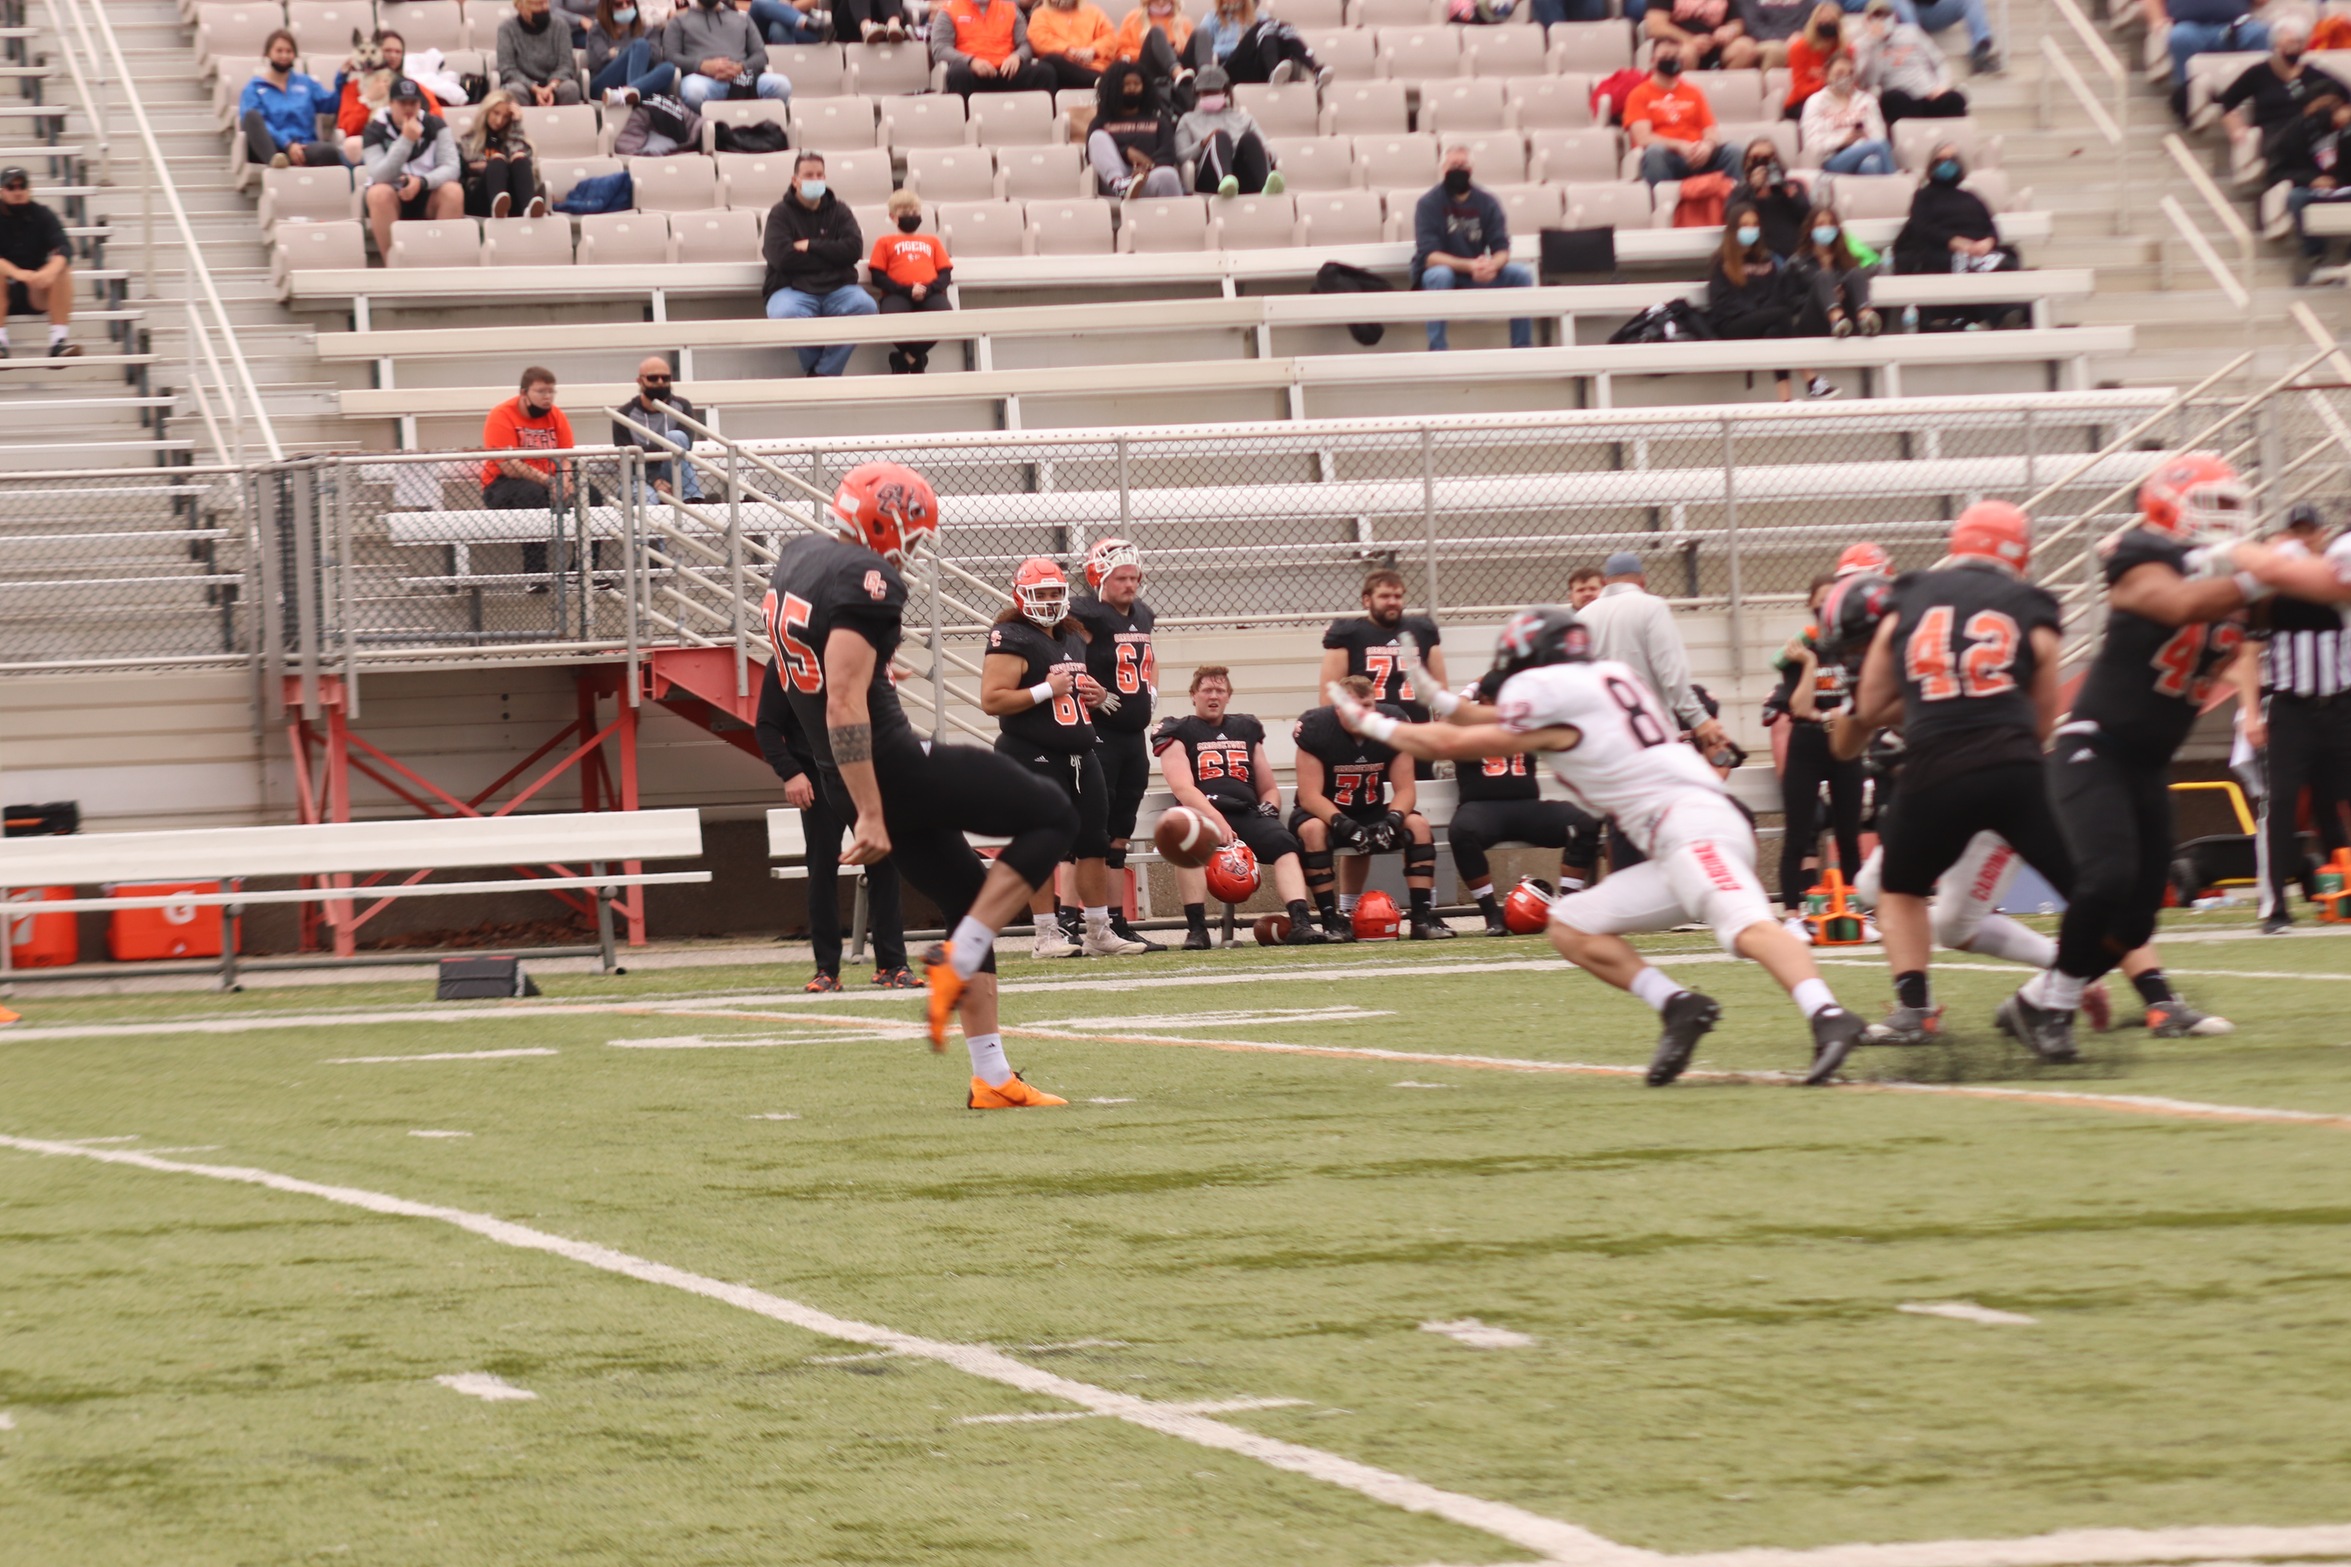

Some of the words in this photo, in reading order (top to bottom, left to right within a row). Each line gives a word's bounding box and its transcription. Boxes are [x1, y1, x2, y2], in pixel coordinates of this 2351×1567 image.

[894, 241, 932, 258] TIGERS
[1115, 643, 1154, 694] 64
[1905, 605, 2021, 701] 42
[1197, 750, 1249, 782] 65
[1333, 773, 1379, 806] 71
